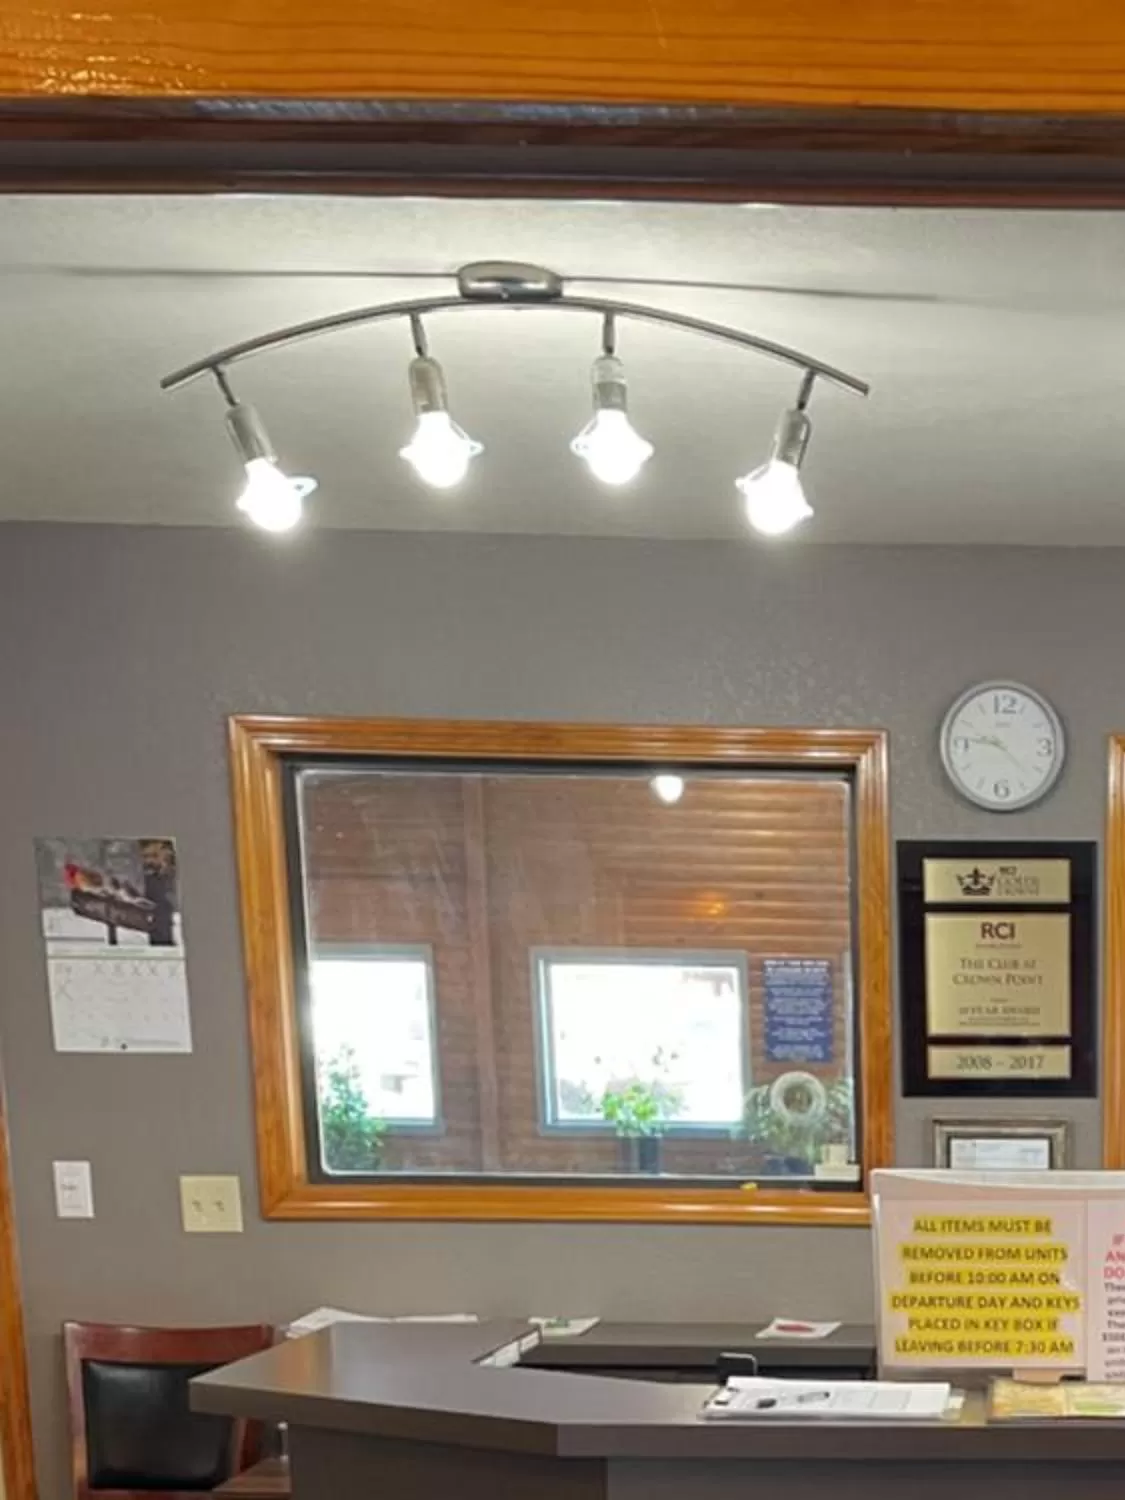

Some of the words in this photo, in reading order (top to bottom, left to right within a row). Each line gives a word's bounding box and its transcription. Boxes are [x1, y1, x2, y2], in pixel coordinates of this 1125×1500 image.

[993, 695, 1017, 714] 12
[953, 735, 969, 757] 9
[1036, 737, 1052, 757] 3
[993, 779, 1011, 798] 6
[980, 921, 1016, 940] RCI
[956, 1055, 993, 1070] 2008
[1009, 1054, 1045, 1070] 2017
[913, 1219, 937, 1233] ALL
[941, 1219, 984, 1233] ITEMS
[988, 1219, 1030, 1233] MUST
[1034, 1219, 1052, 1233] BE
[1112, 1234, 1125, 1246] IF
[902, 1247, 975, 1261] REMOVED
[978, 1247, 1021, 1261] FROM
[1025, 1247, 1068, 1261] UNITS
[909, 1271, 961, 1285] BEFORE
[967, 1271, 1005, 1285] 10:00
[1009, 1271, 1034, 1285] AM
[1037, 1271, 1060, 1285] ON
[1103, 1267, 1125, 1279] DO
[891, 1295, 973, 1310] DEPARTURE
[978, 1295, 1006, 1310] DAY
[1009, 1295, 1042, 1310] AND
[1047, 1295, 1080, 1310] KEYS
[907, 1318, 960, 1331] PLACED
[964, 1318, 979, 1331] IN
[984, 1318, 1009, 1331] KEY
[1014, 1318, 1043, 1331] BOX
[1047, 1318, 1058, 1331] IF
[895, 1340, 953, 1353] LEAVING
[957, 1340, 1010, 1353] BEFORE
[1015, 1340, 1046, 1353] 7:30
[1049, 1340, 1074, 1353] AM
